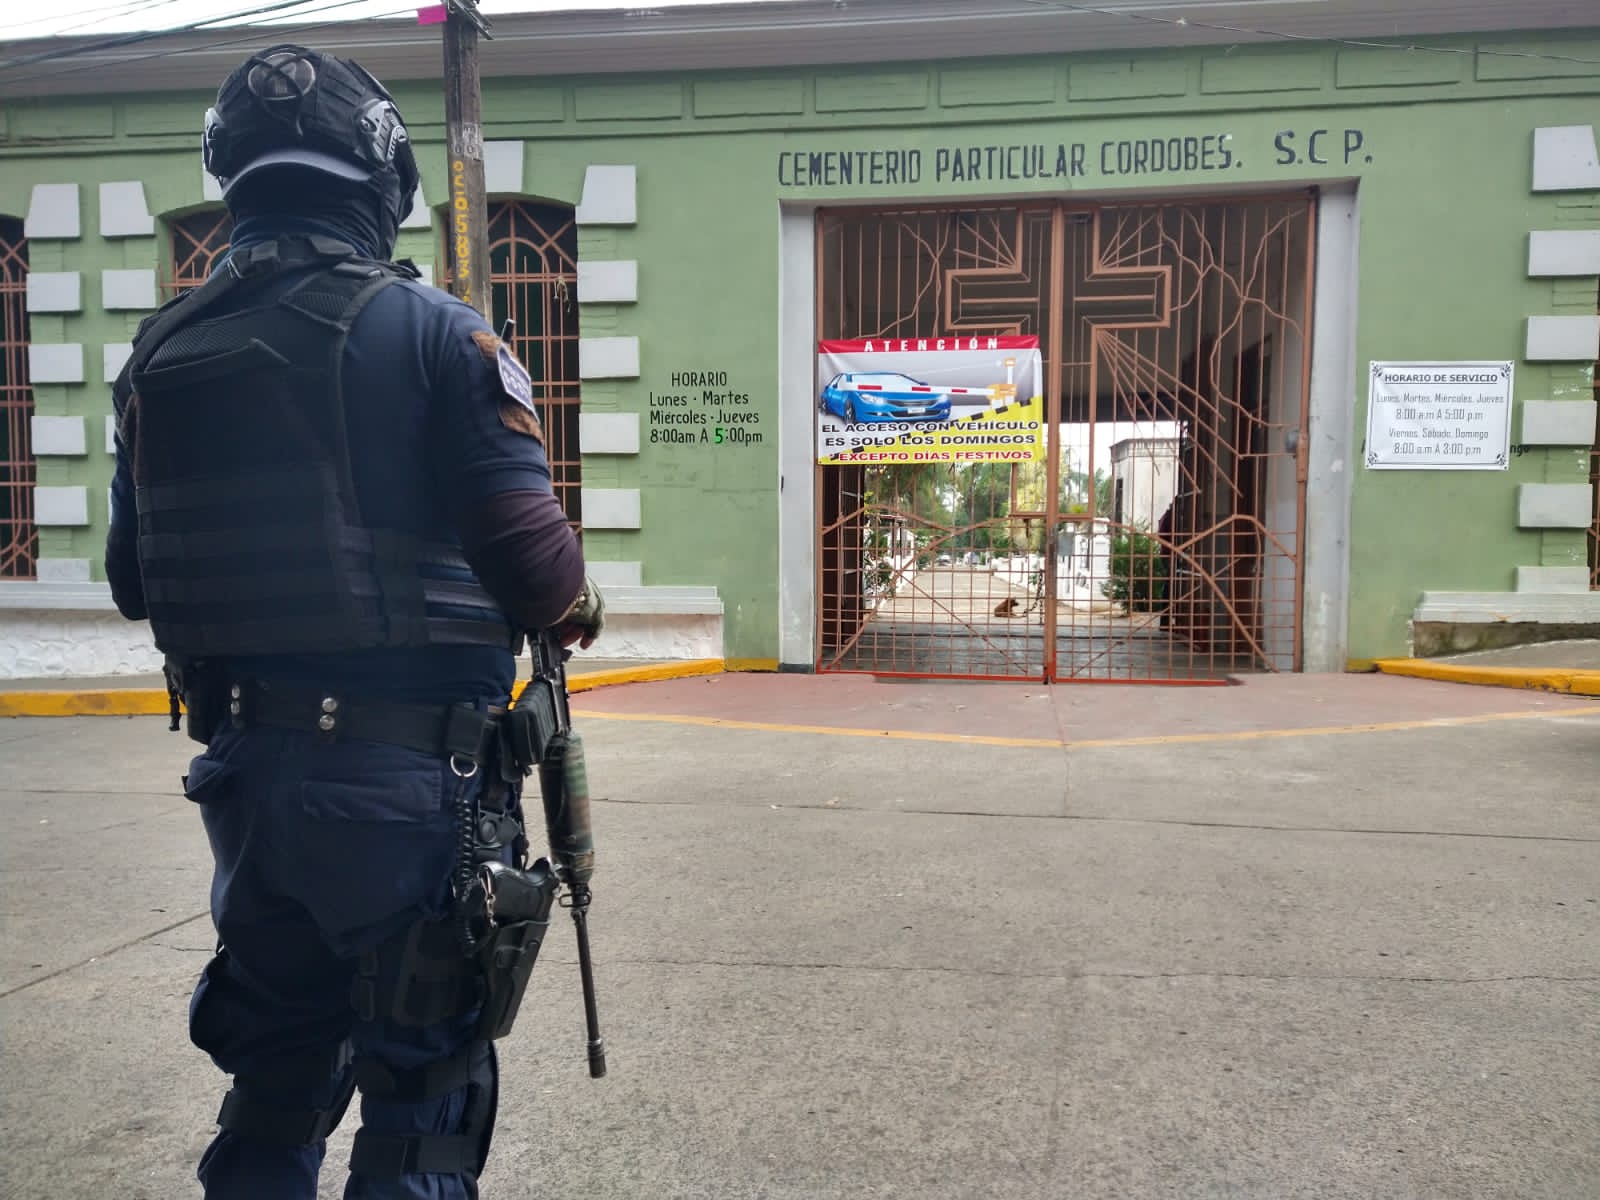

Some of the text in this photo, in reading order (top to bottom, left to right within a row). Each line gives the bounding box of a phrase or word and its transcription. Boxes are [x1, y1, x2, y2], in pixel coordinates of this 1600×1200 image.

[778, 149, 921, 186] CEMENTERIO
[935, 143, 1085, 182] PARTICULAR
[1100, 134, 1242, 175] CORDOBES.
[864, 337, 998, 352] ATENCIÓN
[671, 371, 728, 387] HORARIO
[1384, 374, 1498, 382] HORARIO DE SERVICIO
[649, 390, 749, 406] Lunes Martes
[716, 409, 760, 424] Jueves
[1436, 408, 1442, 419] A
[822, 420, 1039, 433] EL ACCESO CON VEHÍCULO
[650, 427, 762, 447] 8:00am A 5:00pm
[825, 434, 1036, 446] ES SOLO LOS DOMINGOS
[914, 450, 950, 460] DÍAS
[956, 450, 1032, 460] FESTIVOS
[1434, 443, 1441, 455] A
